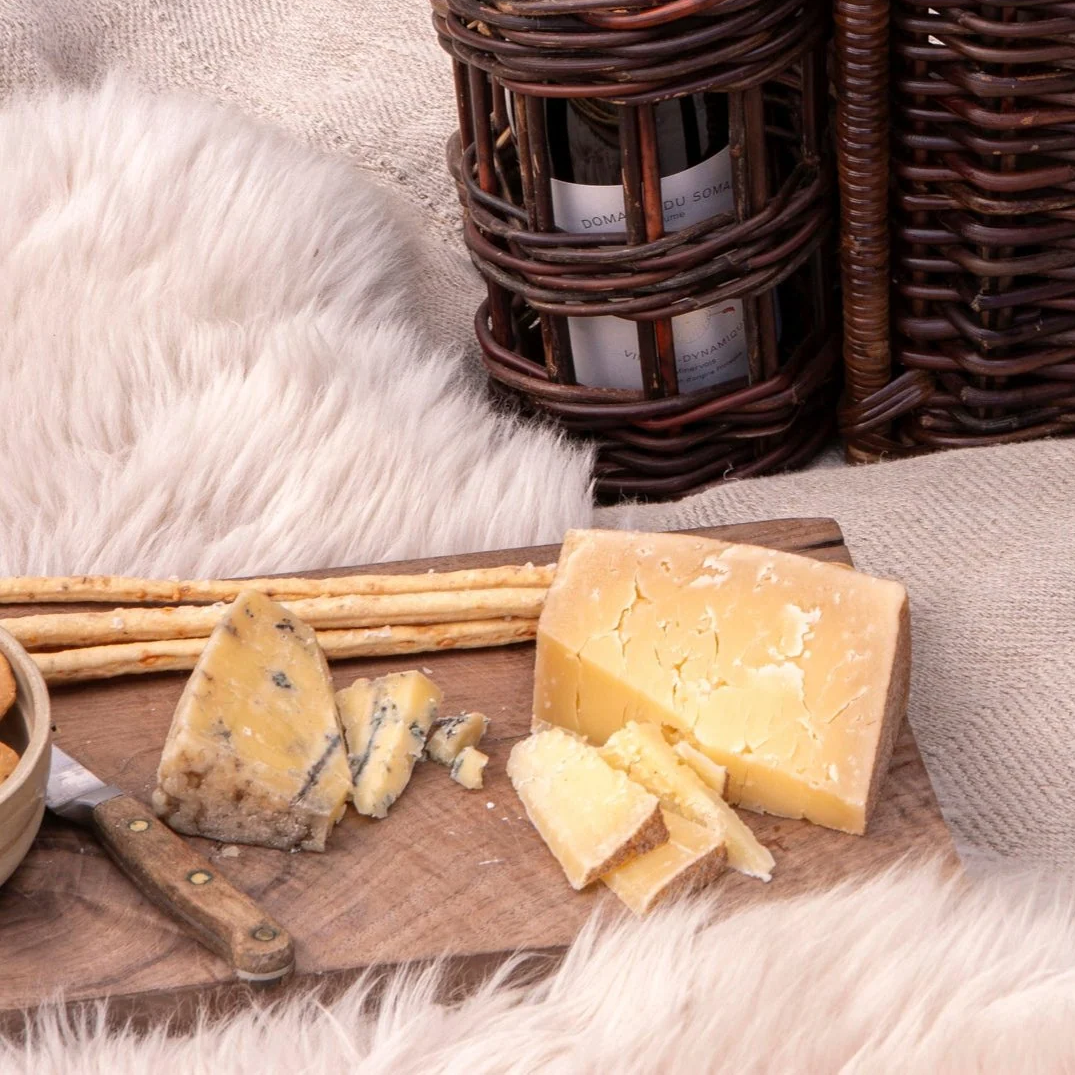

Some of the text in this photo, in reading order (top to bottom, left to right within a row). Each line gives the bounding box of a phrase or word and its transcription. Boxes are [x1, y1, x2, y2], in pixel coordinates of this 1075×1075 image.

[581, 181, 732, 229] DOMA DU SOMA
[664, 211, 686, 223] ume
[624, 349, 640, 361] VI
